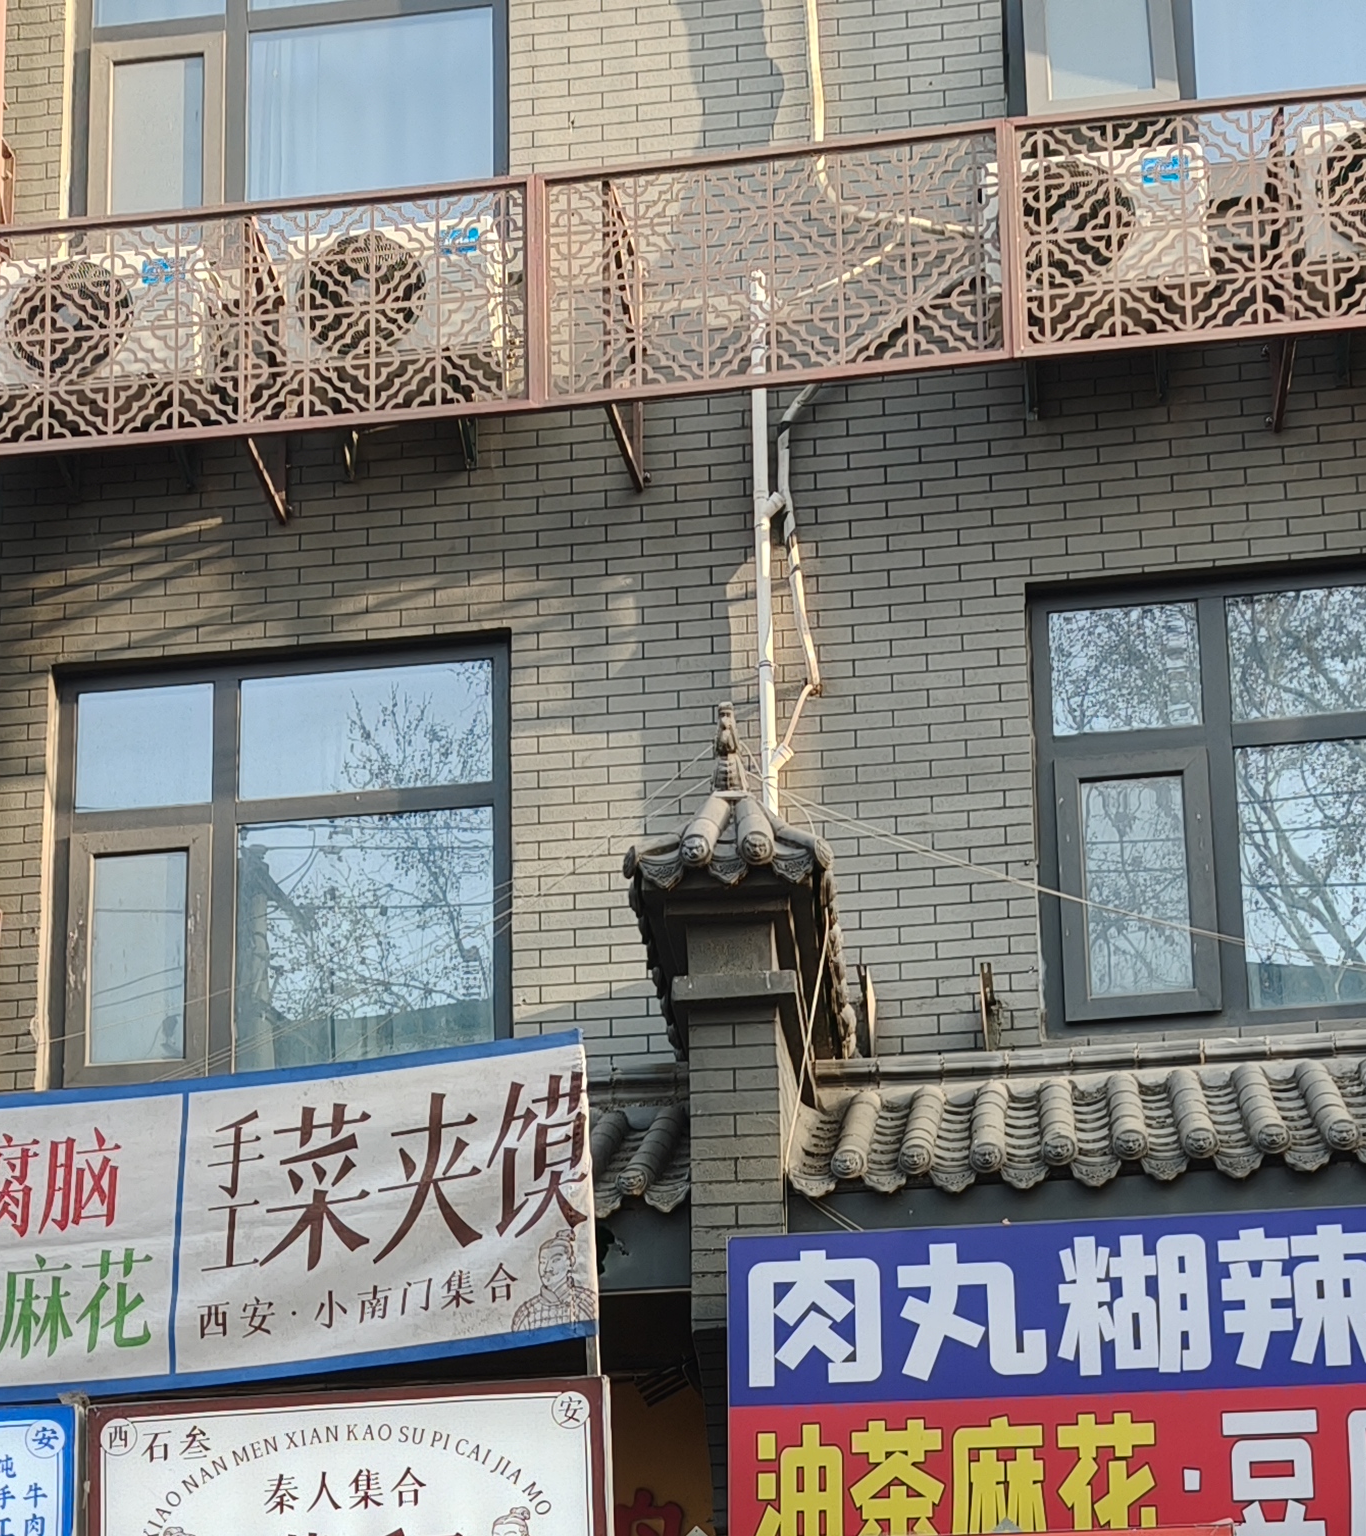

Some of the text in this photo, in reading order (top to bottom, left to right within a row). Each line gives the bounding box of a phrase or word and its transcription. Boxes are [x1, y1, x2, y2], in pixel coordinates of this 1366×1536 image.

[199, 1110, 265, 1272] 手工
[260, 1071, 589, 1271] 菜夹馍
[558, 1397, 584, 1422] 安
[32, 1427, 60, 1451] 安
[108, 1425, 131, 1449] 西
[141, 1426, 212, 1463] 石叁
[182, 1457, 229, 1496] NAN
[232, 1436, 279, 1467] MEN
[285, 1425, 339, 1449] XIAN
[346, 1423, 392, 1442] KAO
[398, 1426, 426, 1445] SU
[455, 1437, 489, 1465] CAI
[490, 1454, 524, 1486] JIA
[523, 1476, 552, 1516] MO
[264, 1467, 427, 1515] 秦人集合
